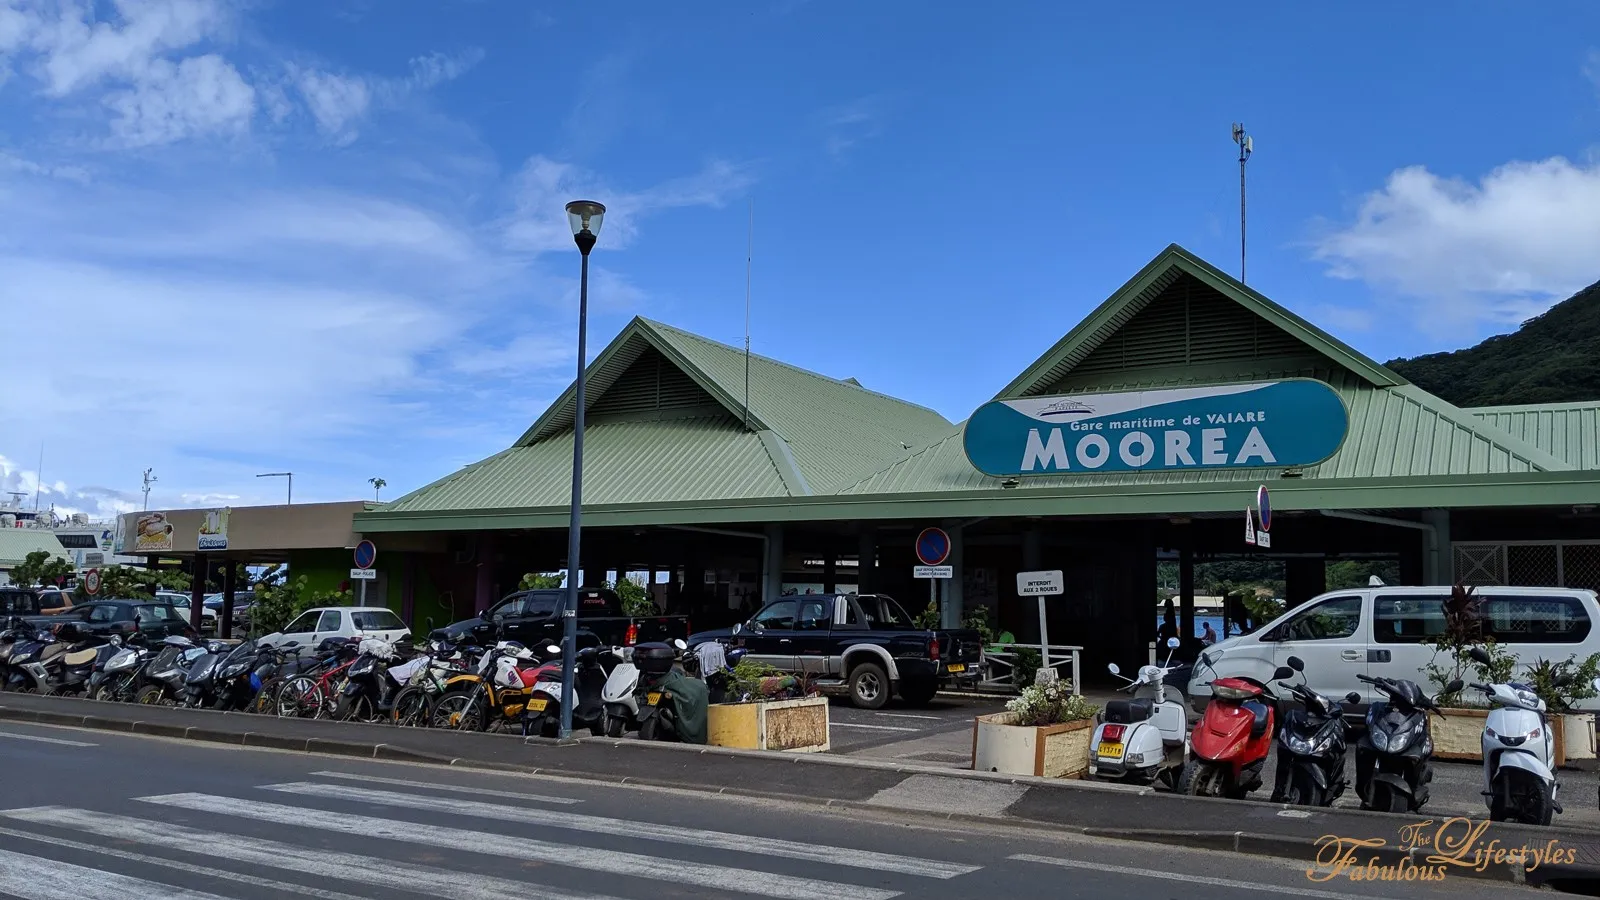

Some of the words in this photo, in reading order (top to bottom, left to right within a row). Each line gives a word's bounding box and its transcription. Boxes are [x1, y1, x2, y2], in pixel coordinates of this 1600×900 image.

[1070, 421, 1103, 431] Gare
[1109, 417, 1175, 429] maritime
[1182, 414, 1200, 426] de
[1206, 411, 1266, 424] VAIARE
[1020, 426, 1276, 471] MOOREA
